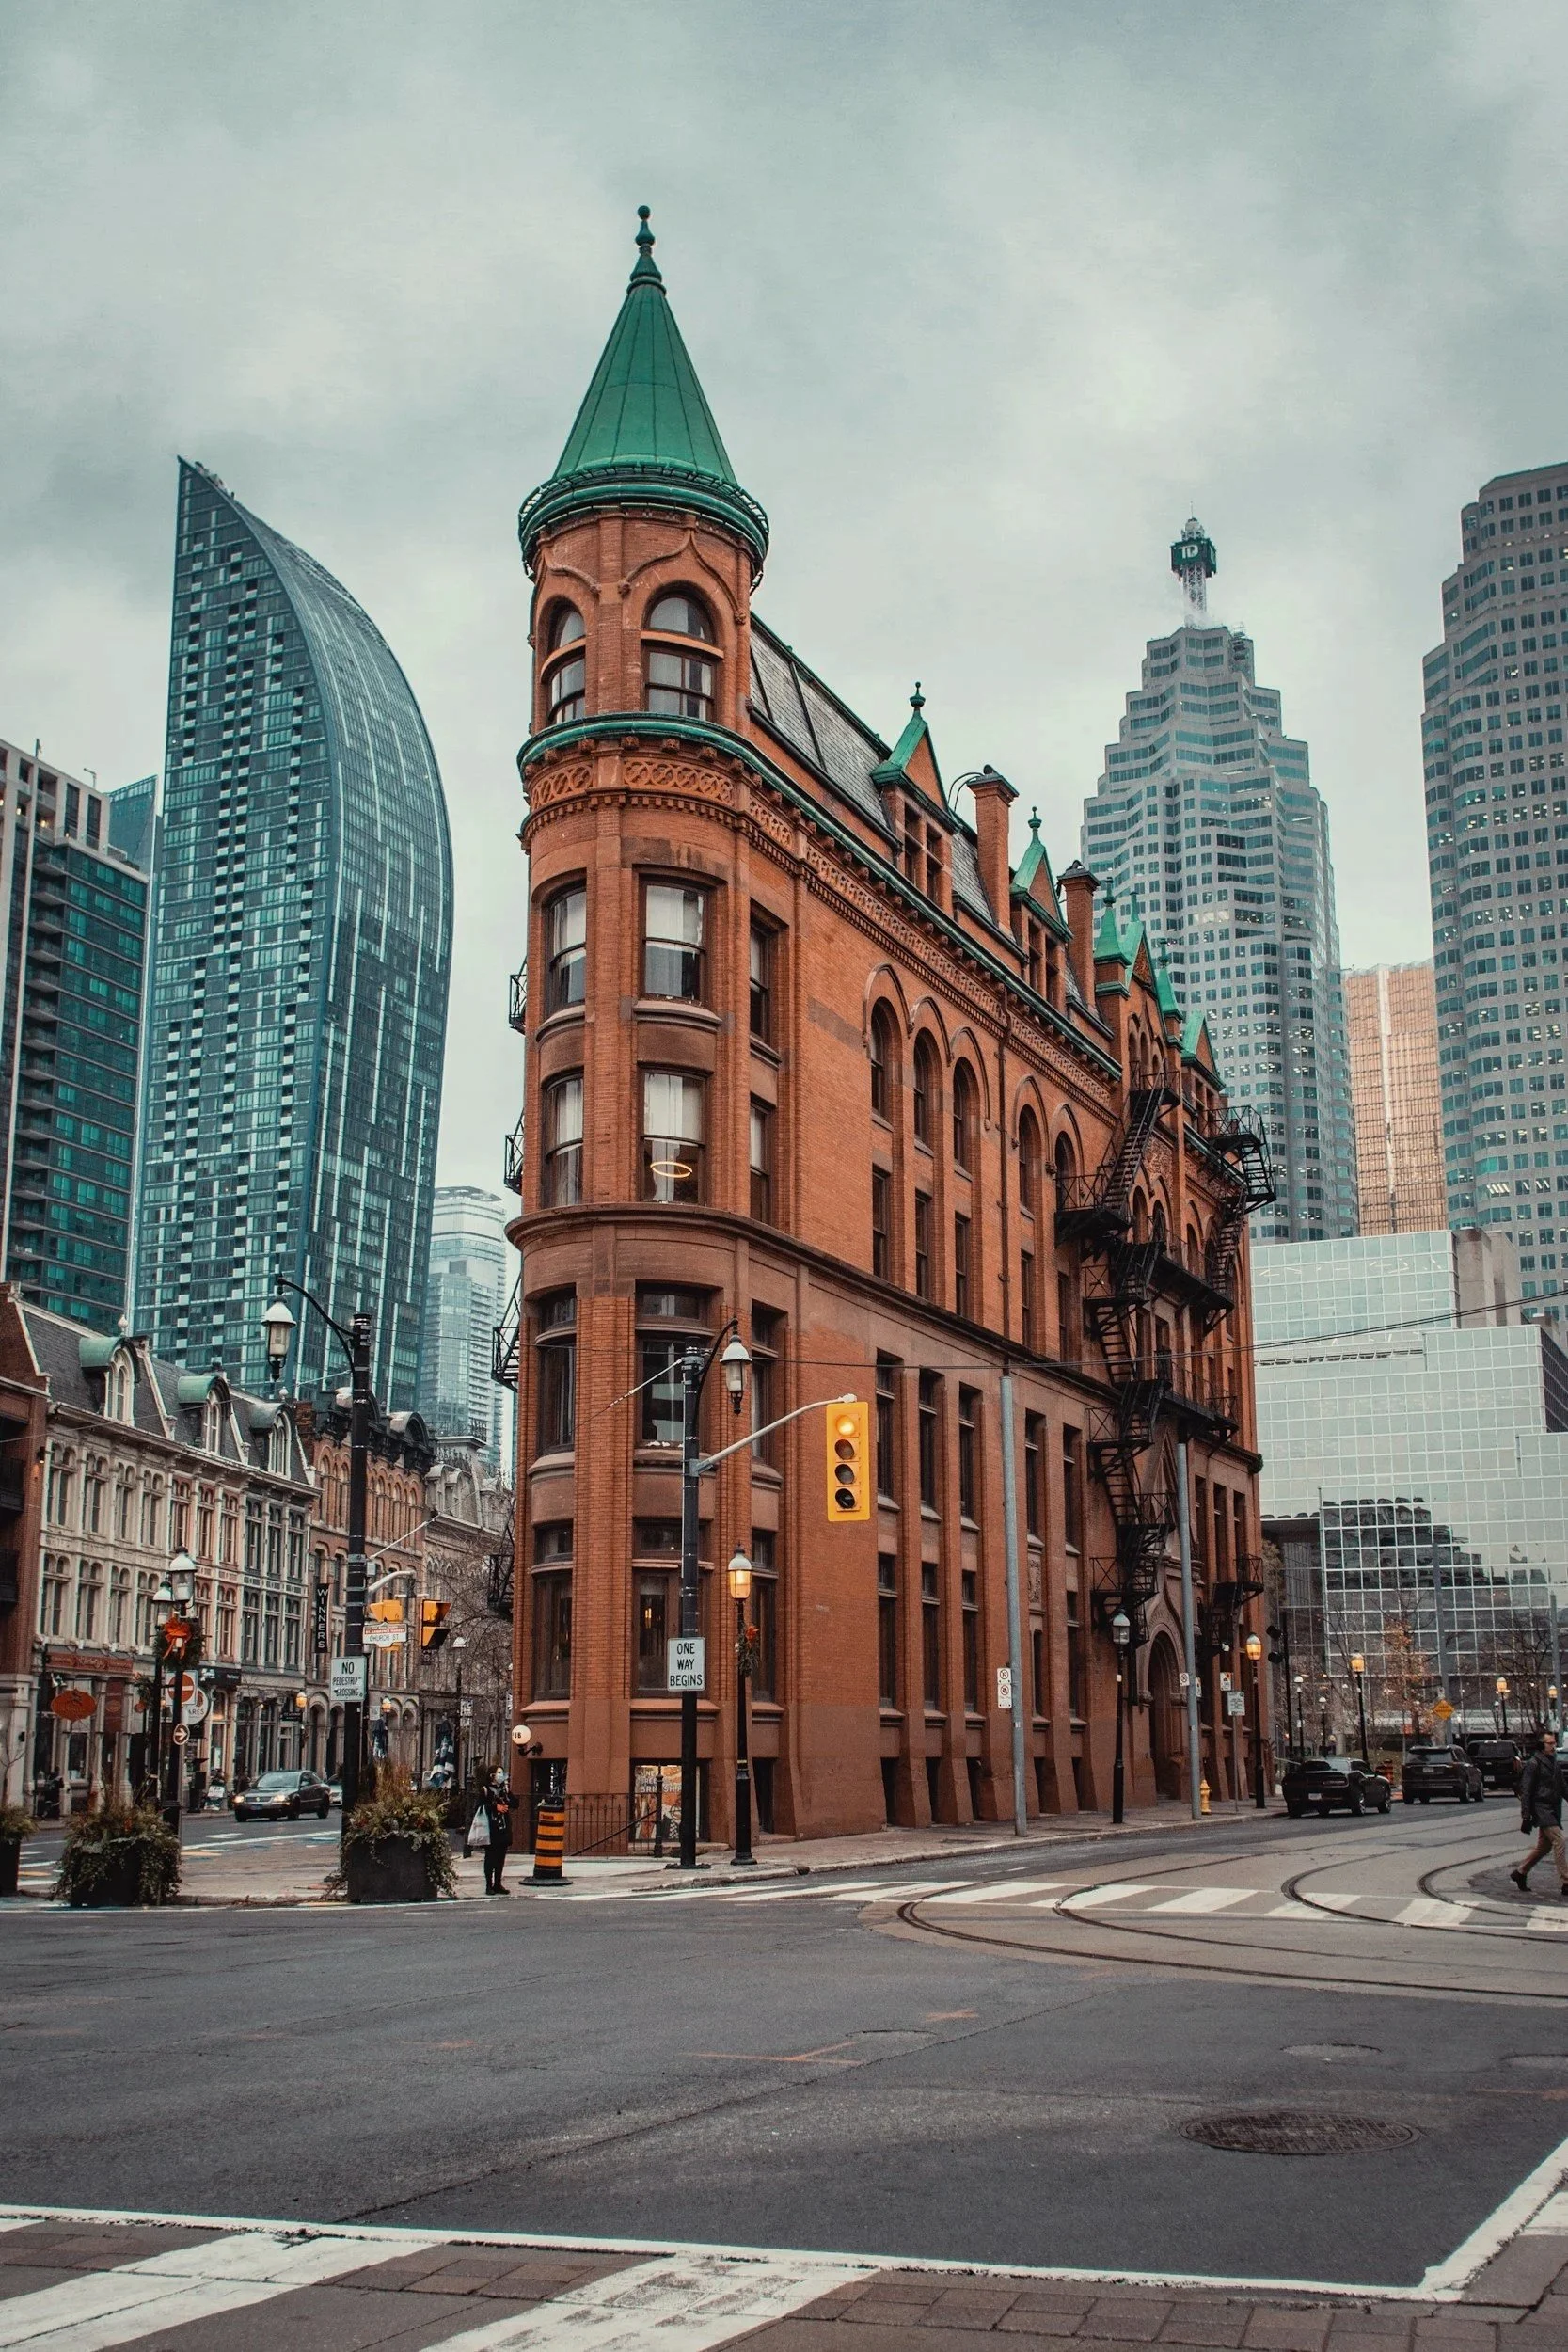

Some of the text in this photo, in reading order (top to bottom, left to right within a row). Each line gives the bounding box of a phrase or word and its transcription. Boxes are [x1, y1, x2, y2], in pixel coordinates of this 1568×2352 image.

[1178, 544, 1198, 559] TD
[317, 1588, 328, 1648] WINNERS
[677, 1642, 695, 1655] ONE
[341, 1661, 355, 1674] NO
[677, 1658, 695, 1670] WAY
[332, 1677, 362, 1685] PEDESTRIA
[670, 1674, 703, 1687] BEGINS
